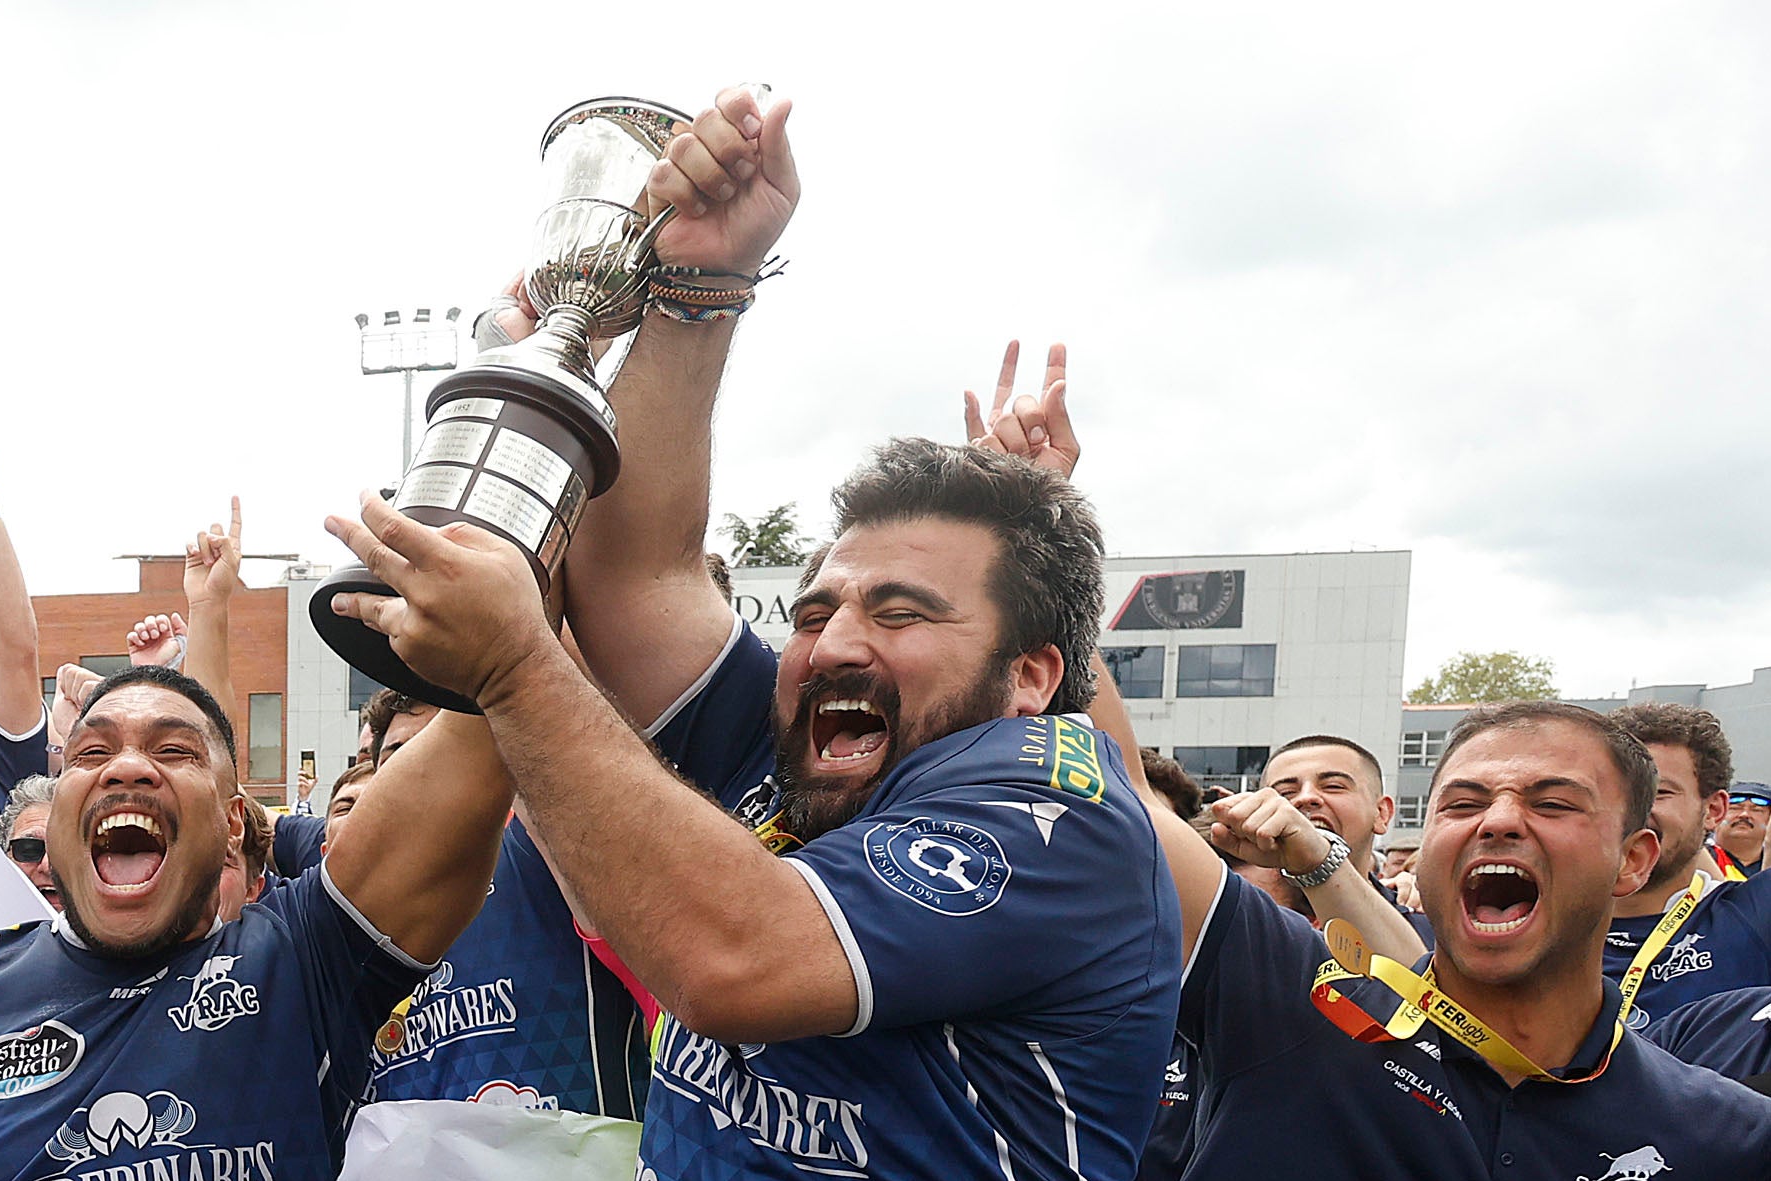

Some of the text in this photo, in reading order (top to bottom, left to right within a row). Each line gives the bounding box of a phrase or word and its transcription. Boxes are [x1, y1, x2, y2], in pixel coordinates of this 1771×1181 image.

[969, 832, 991, 852] DE
[872, 844, 942, 905] DESDE 1994
[167, 986, 260, 1032] VRAC
[1434, 999, 1490, 1042] FERugby
[1383, 1060, 1433, 1096] CASTILLA
[1433, 1087, 1443, 1100] Y
